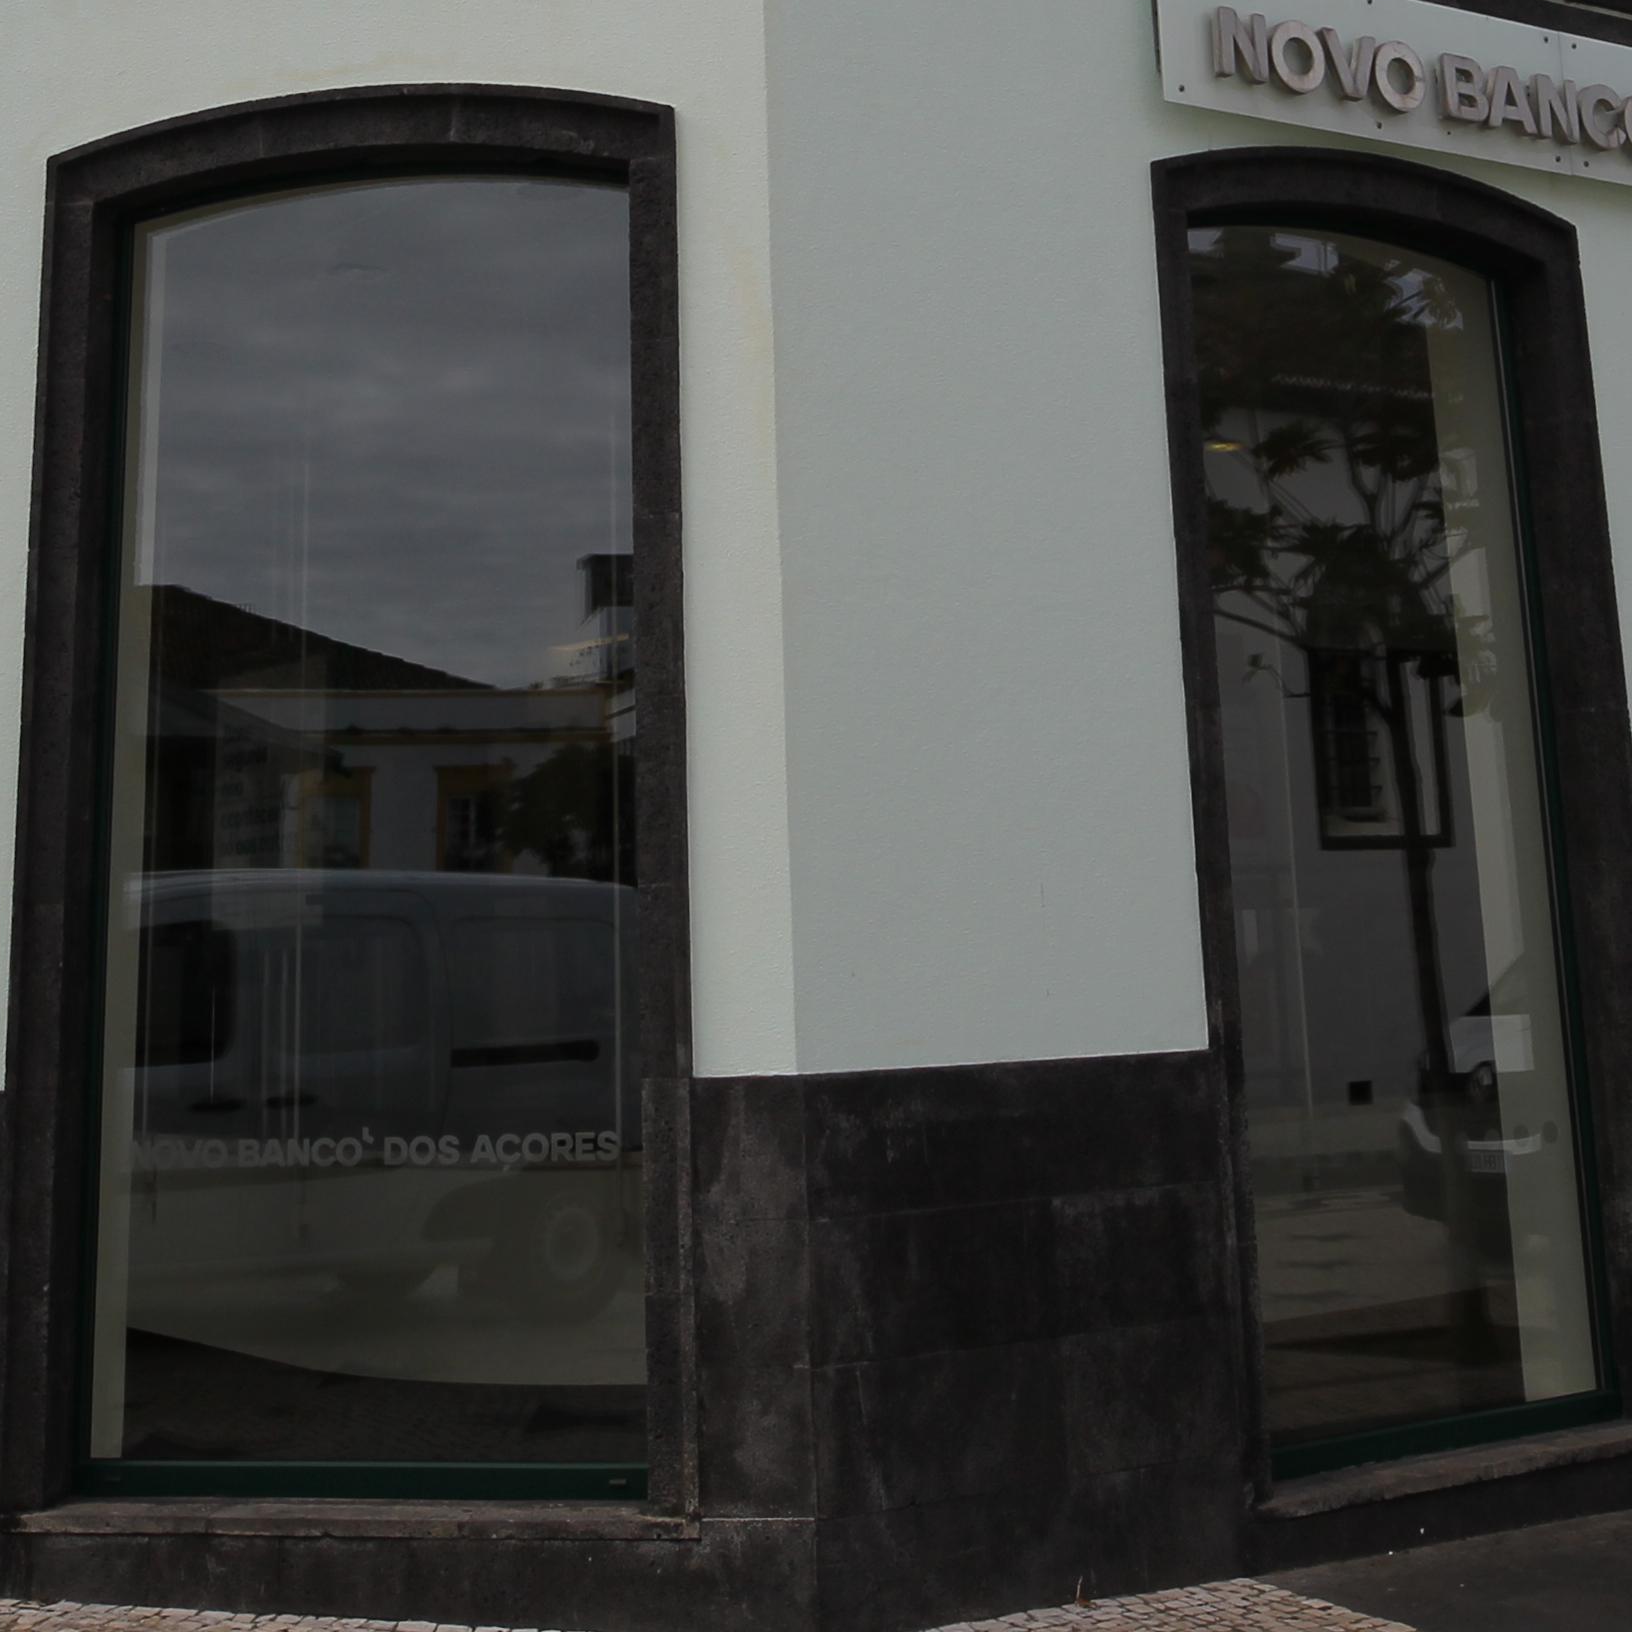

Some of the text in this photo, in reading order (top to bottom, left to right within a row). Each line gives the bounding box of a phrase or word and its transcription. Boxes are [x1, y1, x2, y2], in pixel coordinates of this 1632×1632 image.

[1211, 5, 1428, 114] NOVO
[383, 1135, 462, 1167] DOS
[470, 1130, 622, 1172] AÇORES
